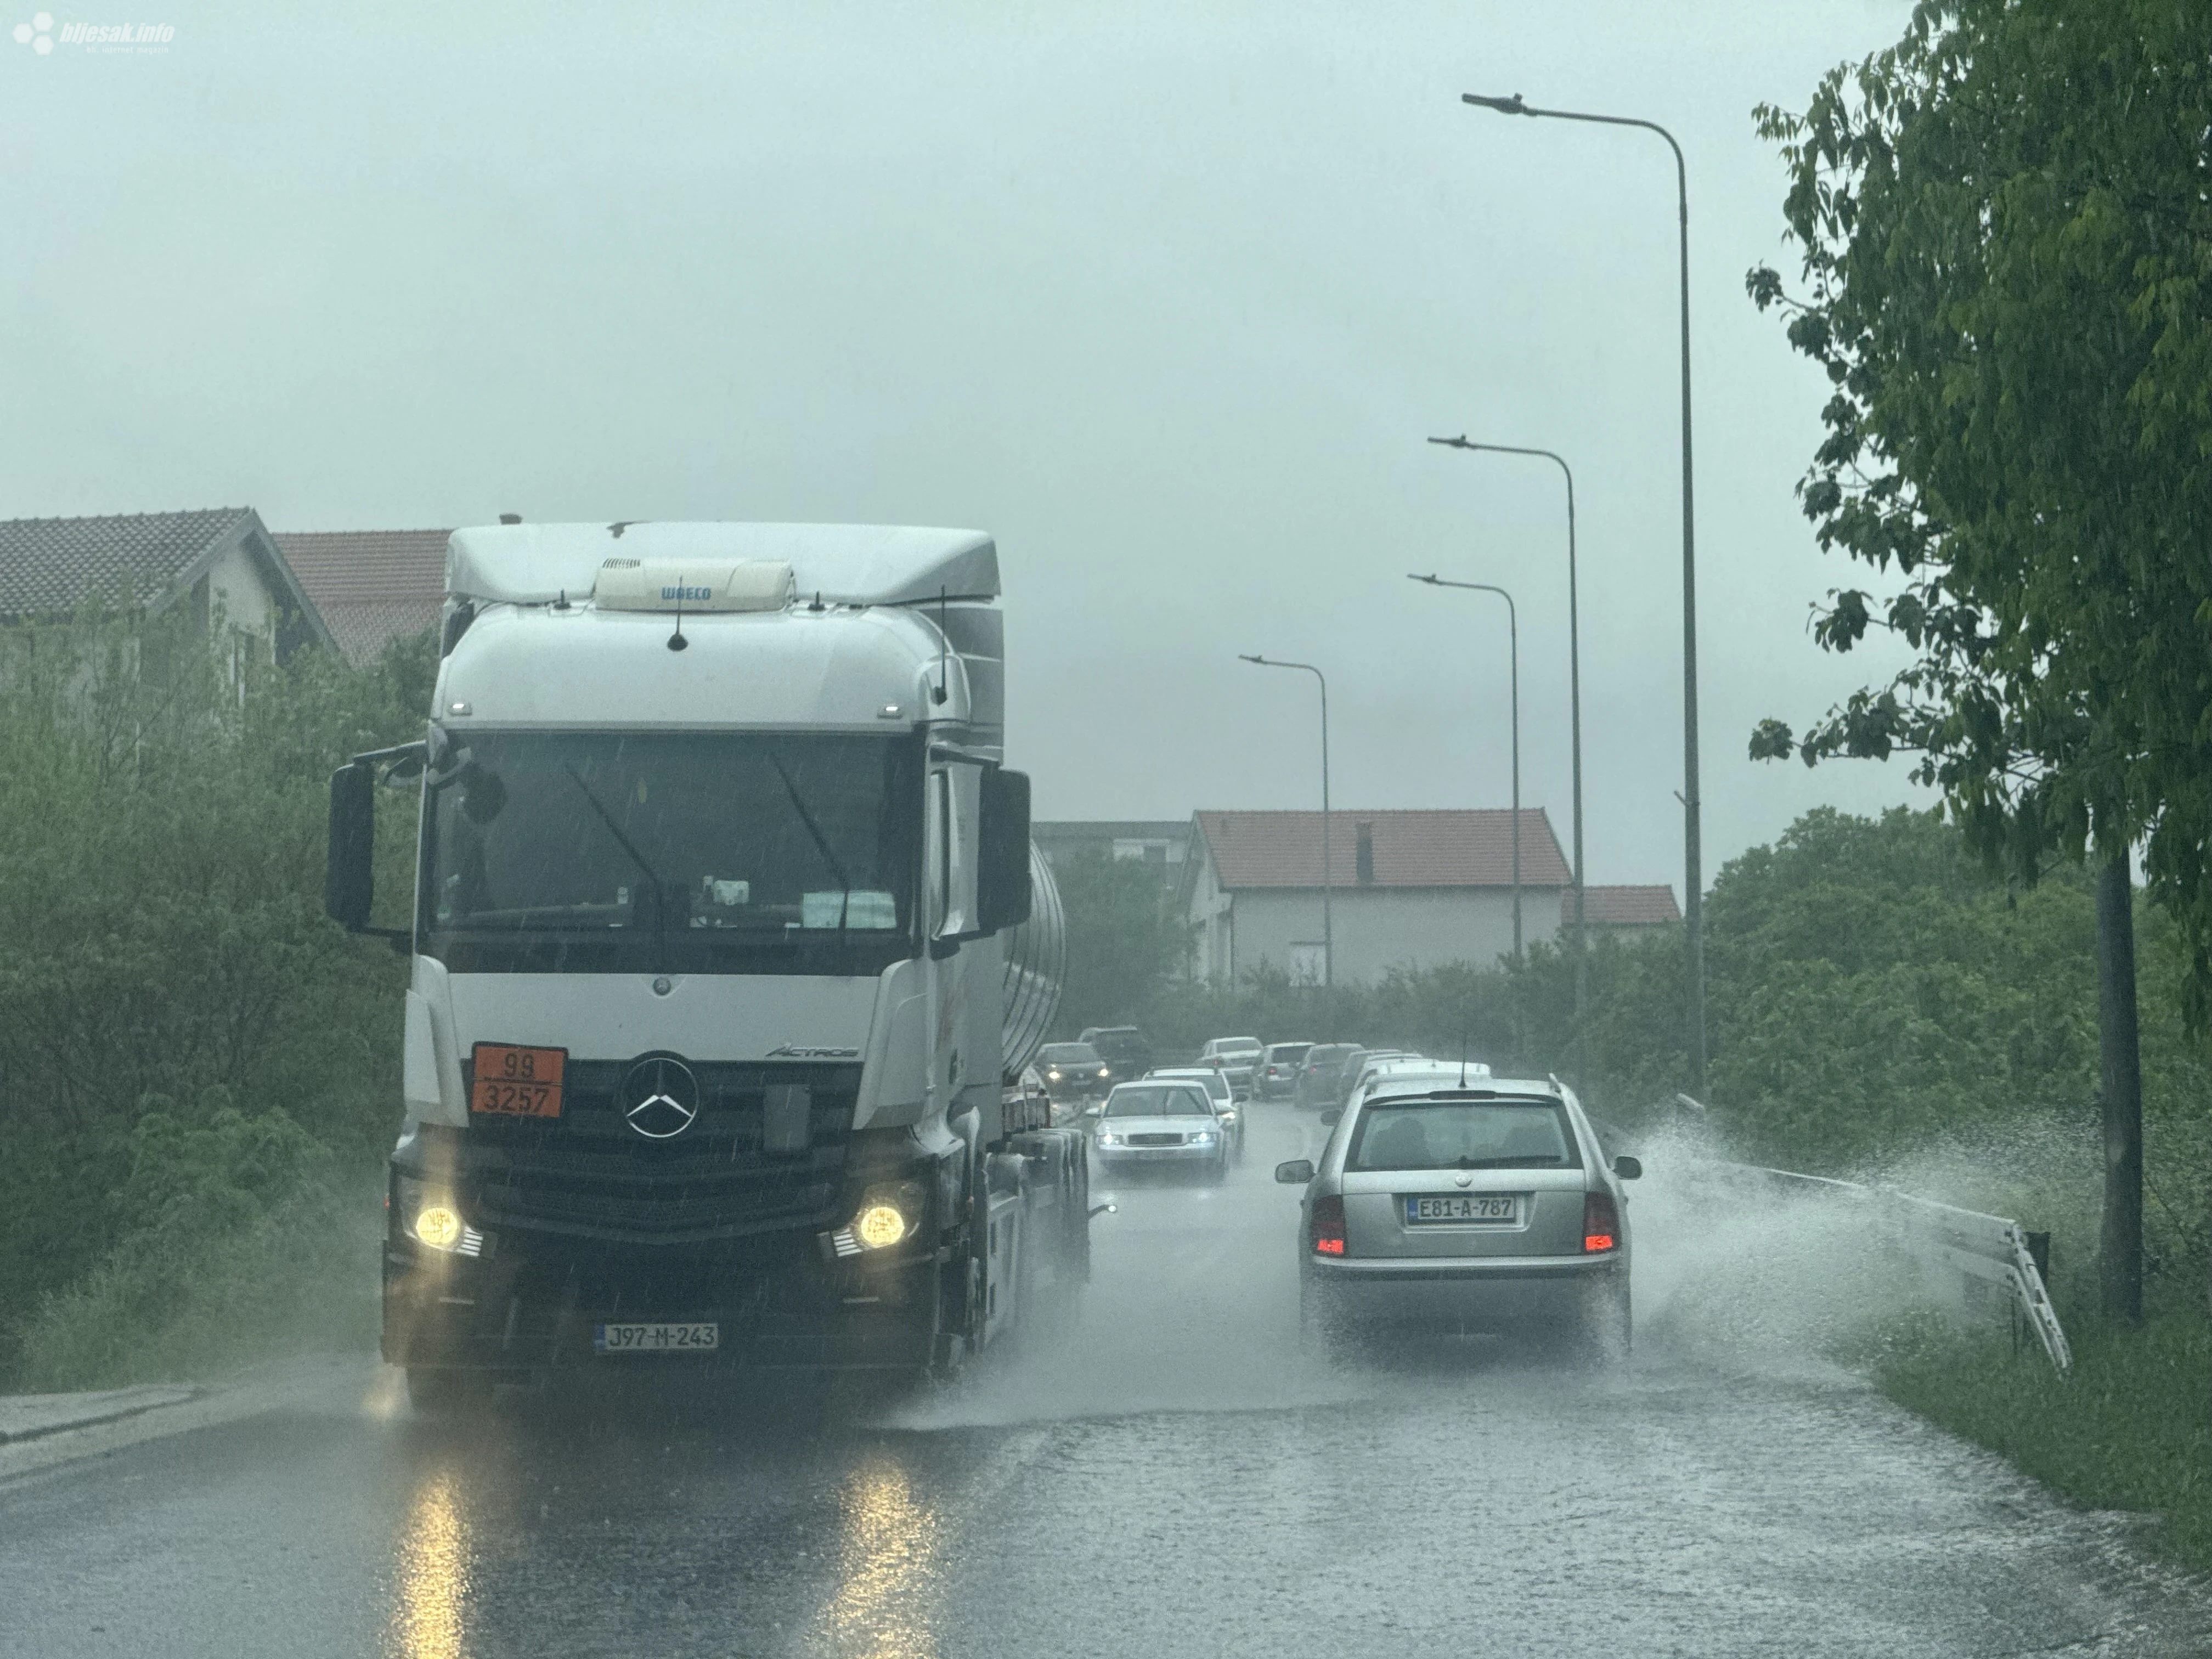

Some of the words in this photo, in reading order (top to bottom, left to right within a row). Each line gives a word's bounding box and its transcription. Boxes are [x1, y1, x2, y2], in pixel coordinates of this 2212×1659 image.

[661, 587, 711, 600] WAECO
[505, 1053, 534, 1077] 99
[484, 1085, 549, 1113] 3257
[1420, 1199, 1511, 1217] E81-A-787
[610, 1326, 714, 1346] J97-M-243
